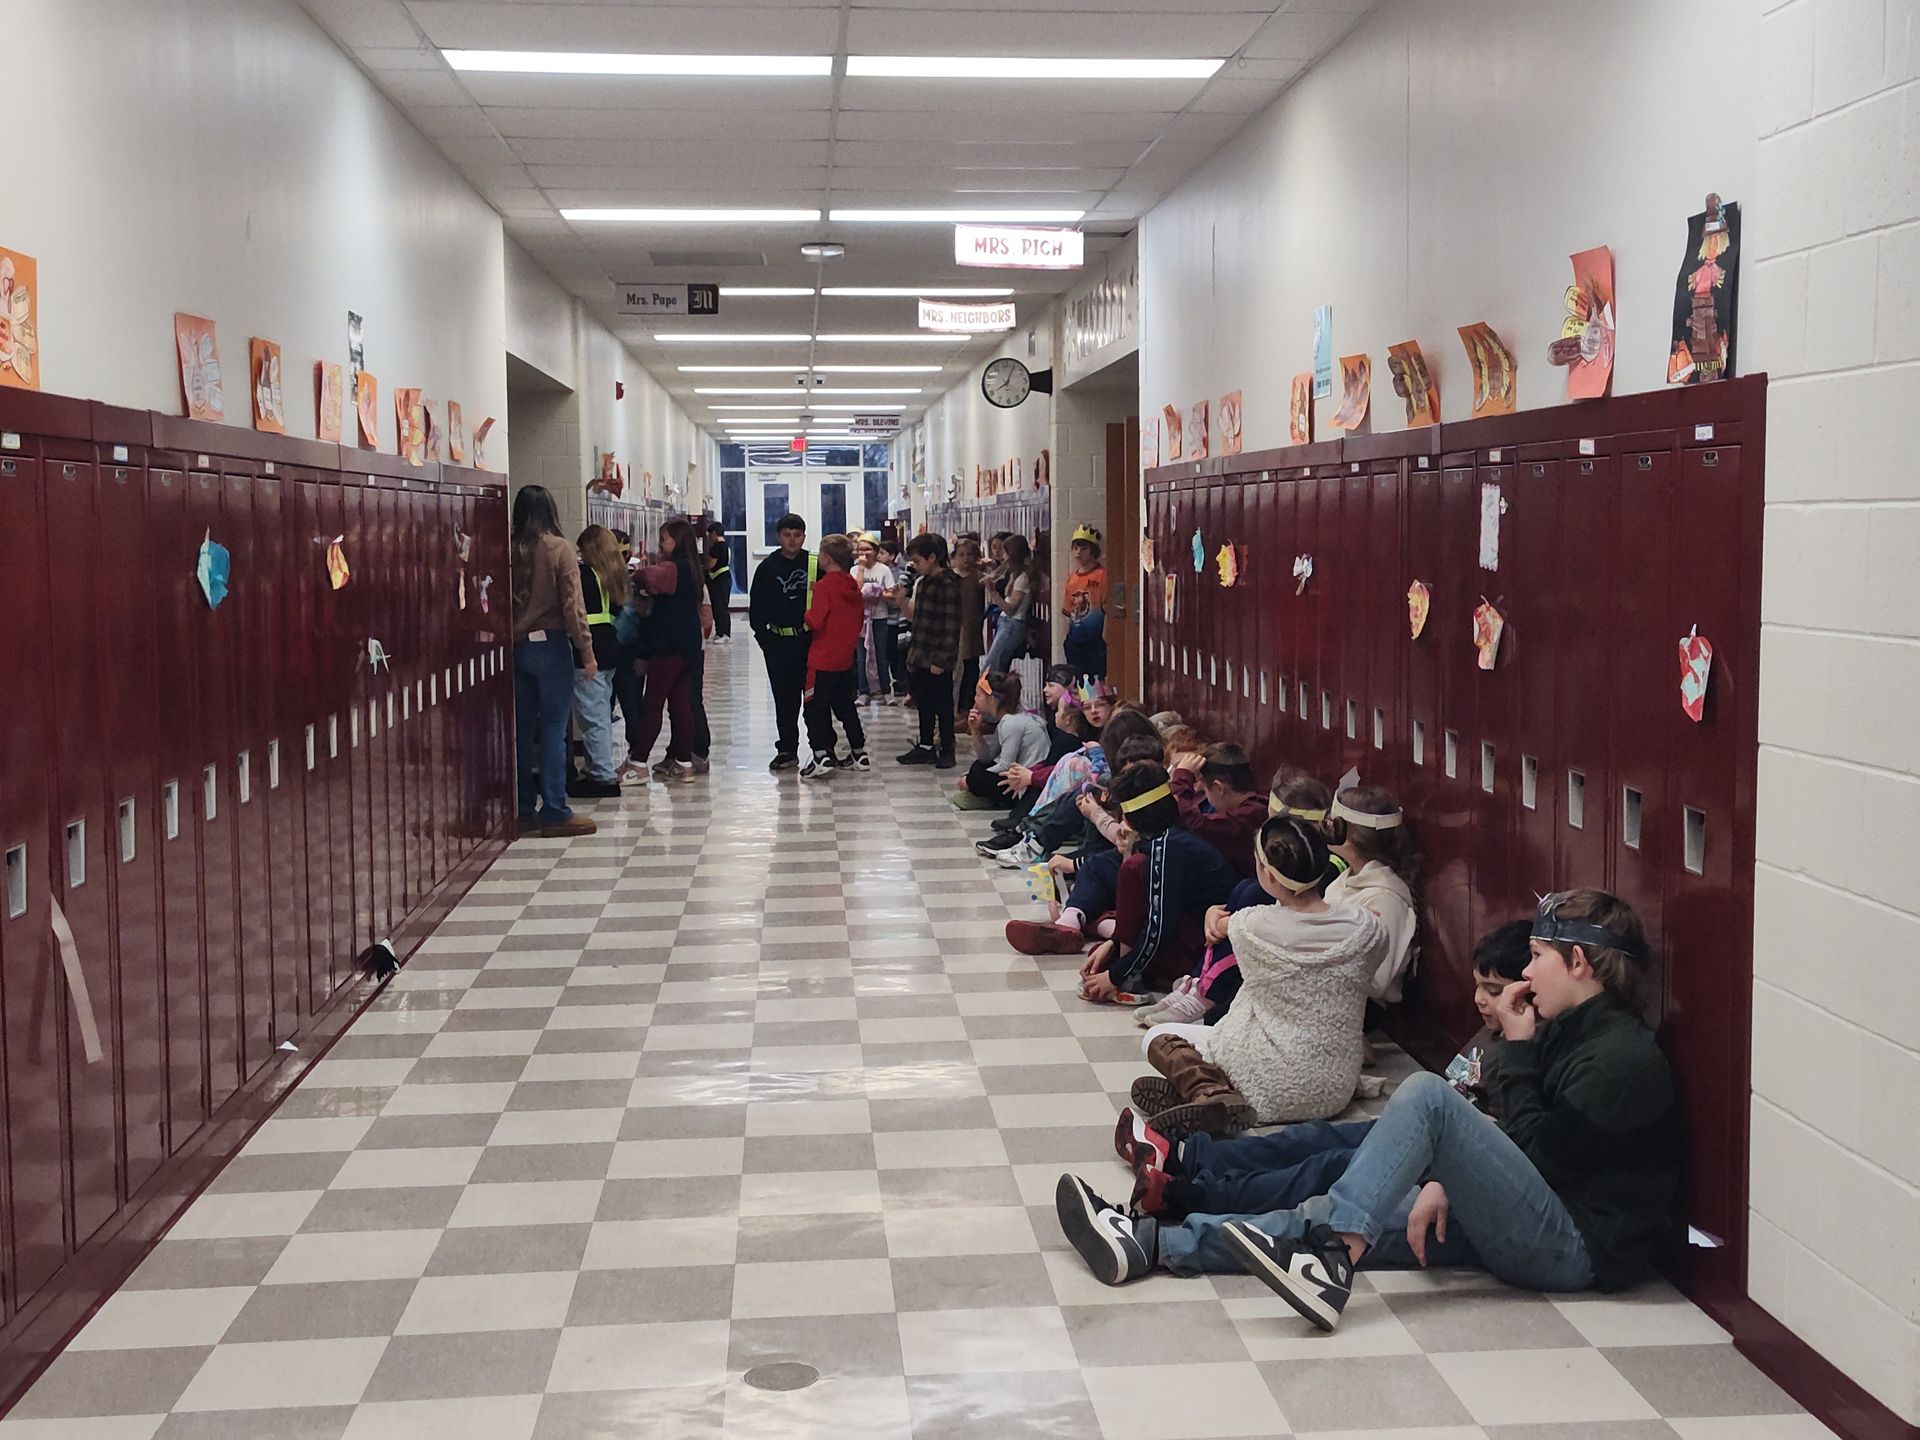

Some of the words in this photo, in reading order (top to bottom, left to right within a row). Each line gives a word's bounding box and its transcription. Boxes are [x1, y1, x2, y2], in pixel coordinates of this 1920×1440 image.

[974, 237, 1016, 256] MRS.
[1021, 238, 1063, 257] RICH
[626, 292, 649, 306] Mrs.
[922, 308, 948, 324] MRS.
[950, 308, 1012, 325] NEIGHBORS
